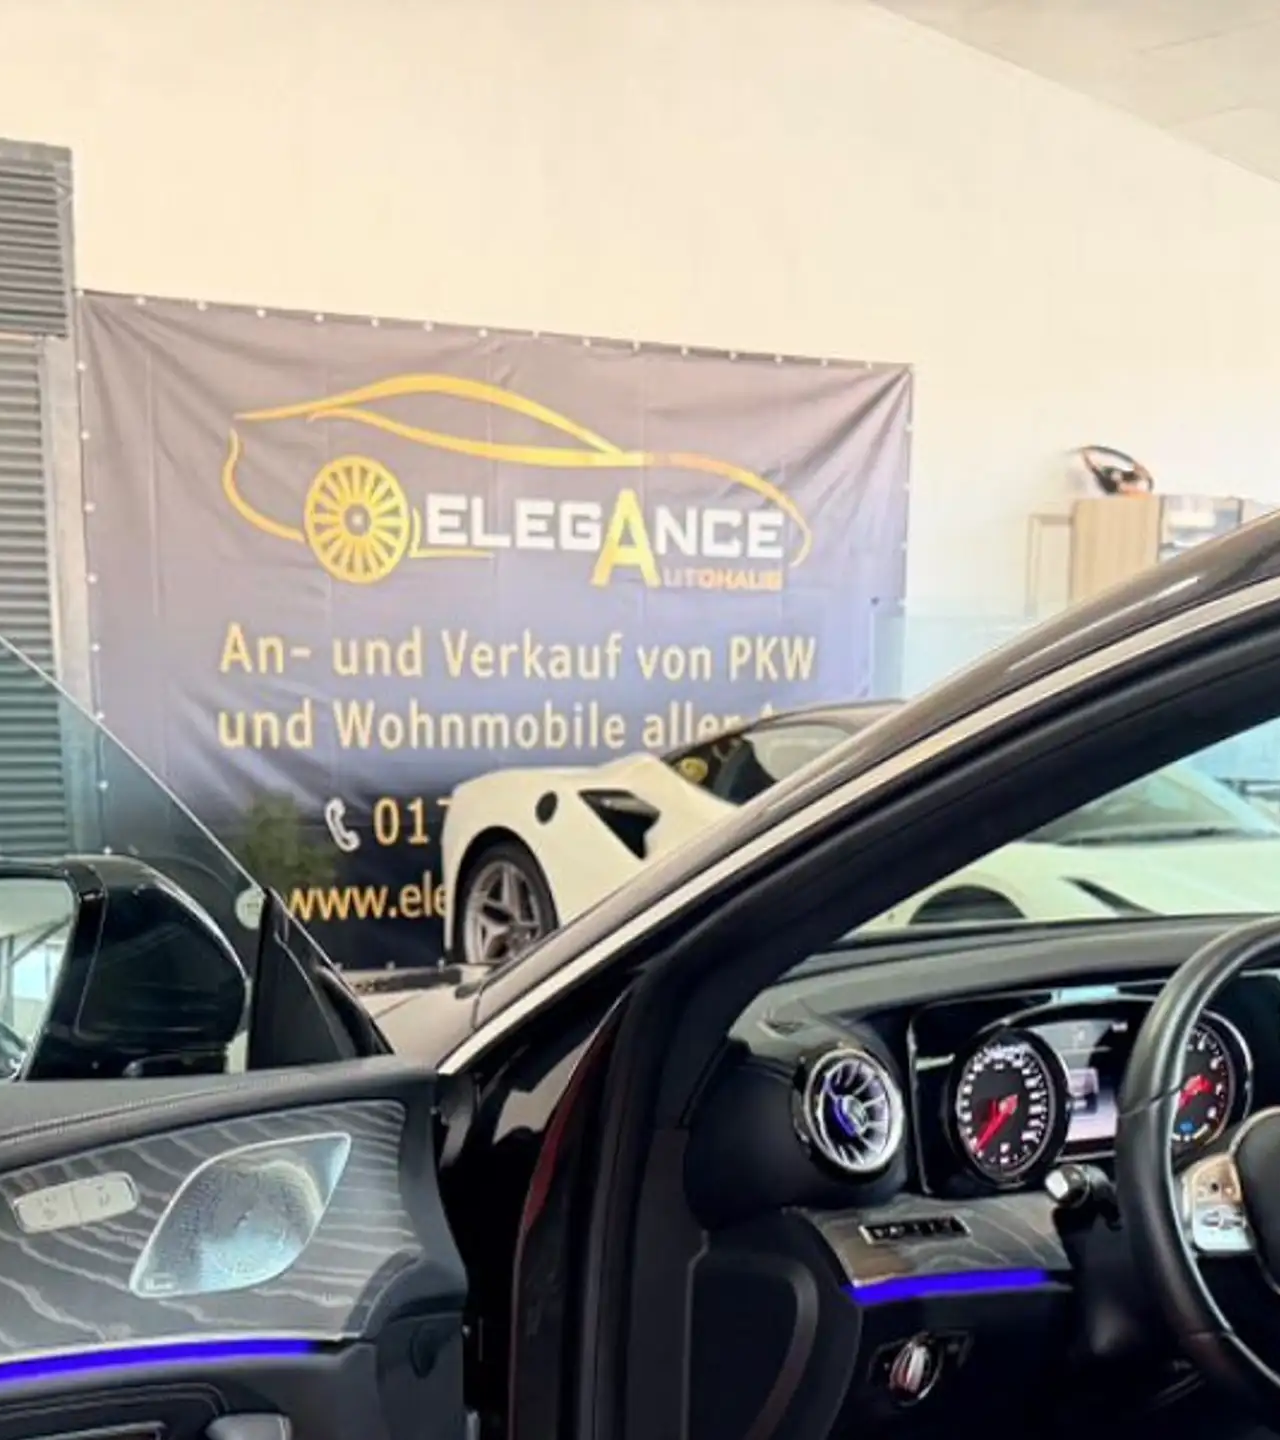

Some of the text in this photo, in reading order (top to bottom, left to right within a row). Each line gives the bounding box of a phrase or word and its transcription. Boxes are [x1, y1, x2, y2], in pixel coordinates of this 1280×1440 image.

[425, 488, 785, 588] ELEGANCE
[219, 622, 817, 683] An- und Verkauf von PKW
[218, 697, 313, 749] und
[332, 697, 626, 750] Wohnmobile
